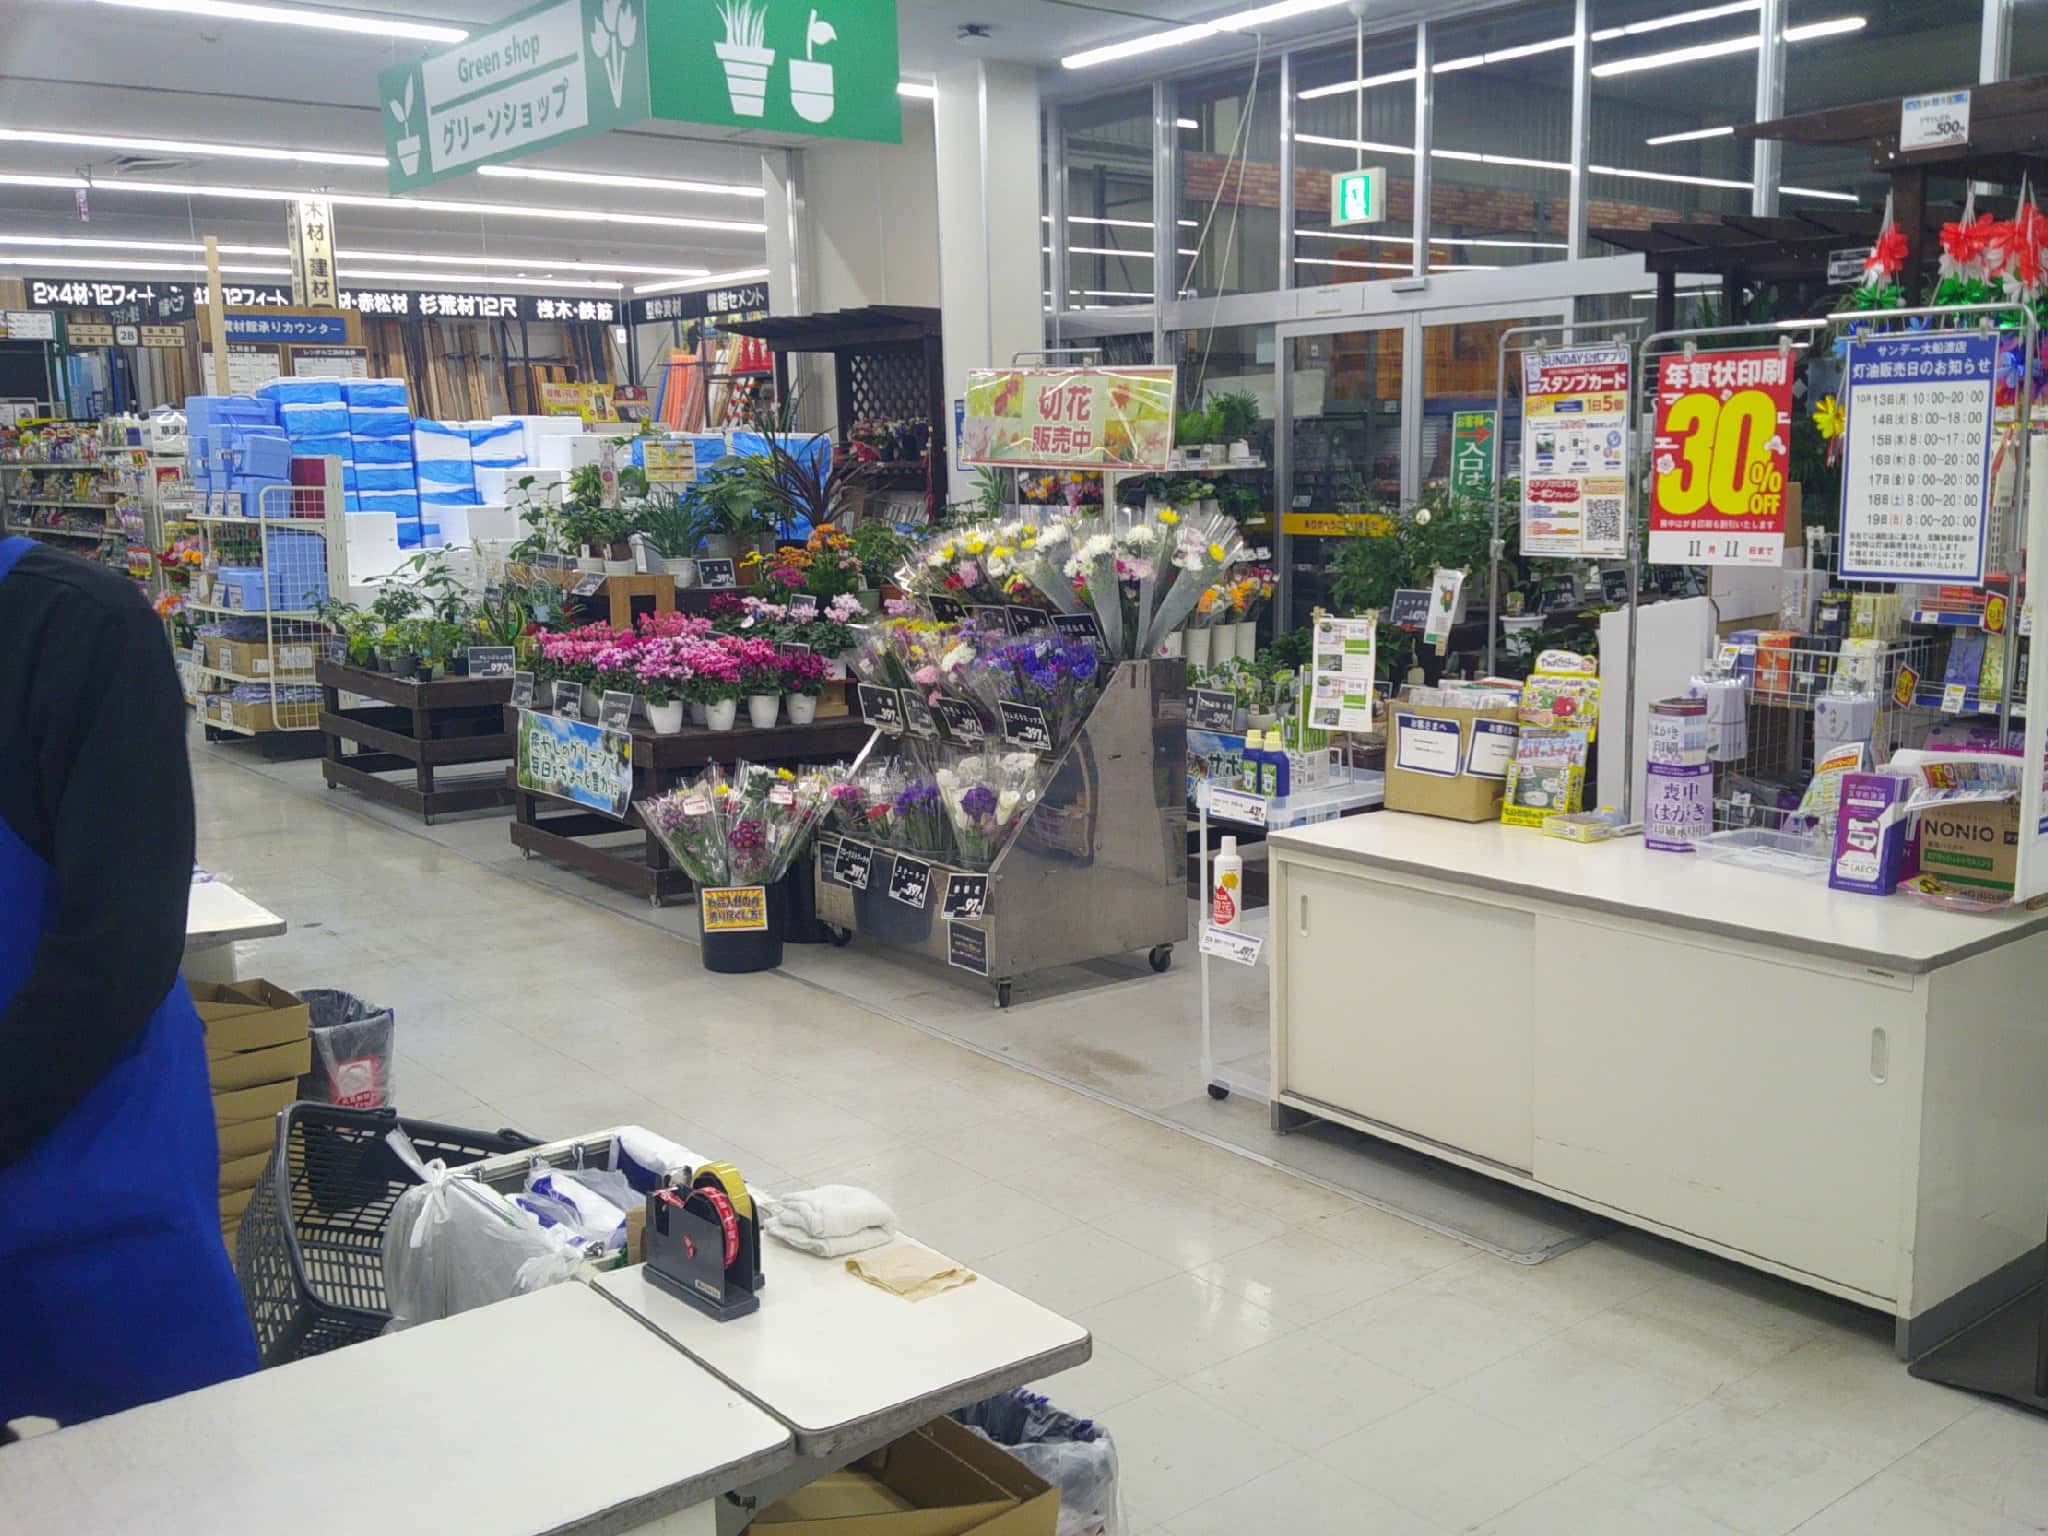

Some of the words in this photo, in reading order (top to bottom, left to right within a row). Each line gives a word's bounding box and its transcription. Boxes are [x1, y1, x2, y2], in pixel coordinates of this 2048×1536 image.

[458, 50, 500, 84] Green
[505, 32, 541, 71] shop
[442, 77, 569, 156] グリーンショップ
[1664, 357, 1788, 389] 年賀状印刷
[1852, 357, 1992, 379] 灯油販売日のお知らせ
[1539, 371, 1627, 393] スタンプカード
[1038, 385, 1092, 422] 切花
[1031, 425, 1092, 455] 販売中
[1750, 494, 1780, 515] OFF
[1664, 782, 1699, 801] 喪中
[1654, 803, 1705, 823] はがき
[1924, 819, 1994, 843] NONIO
